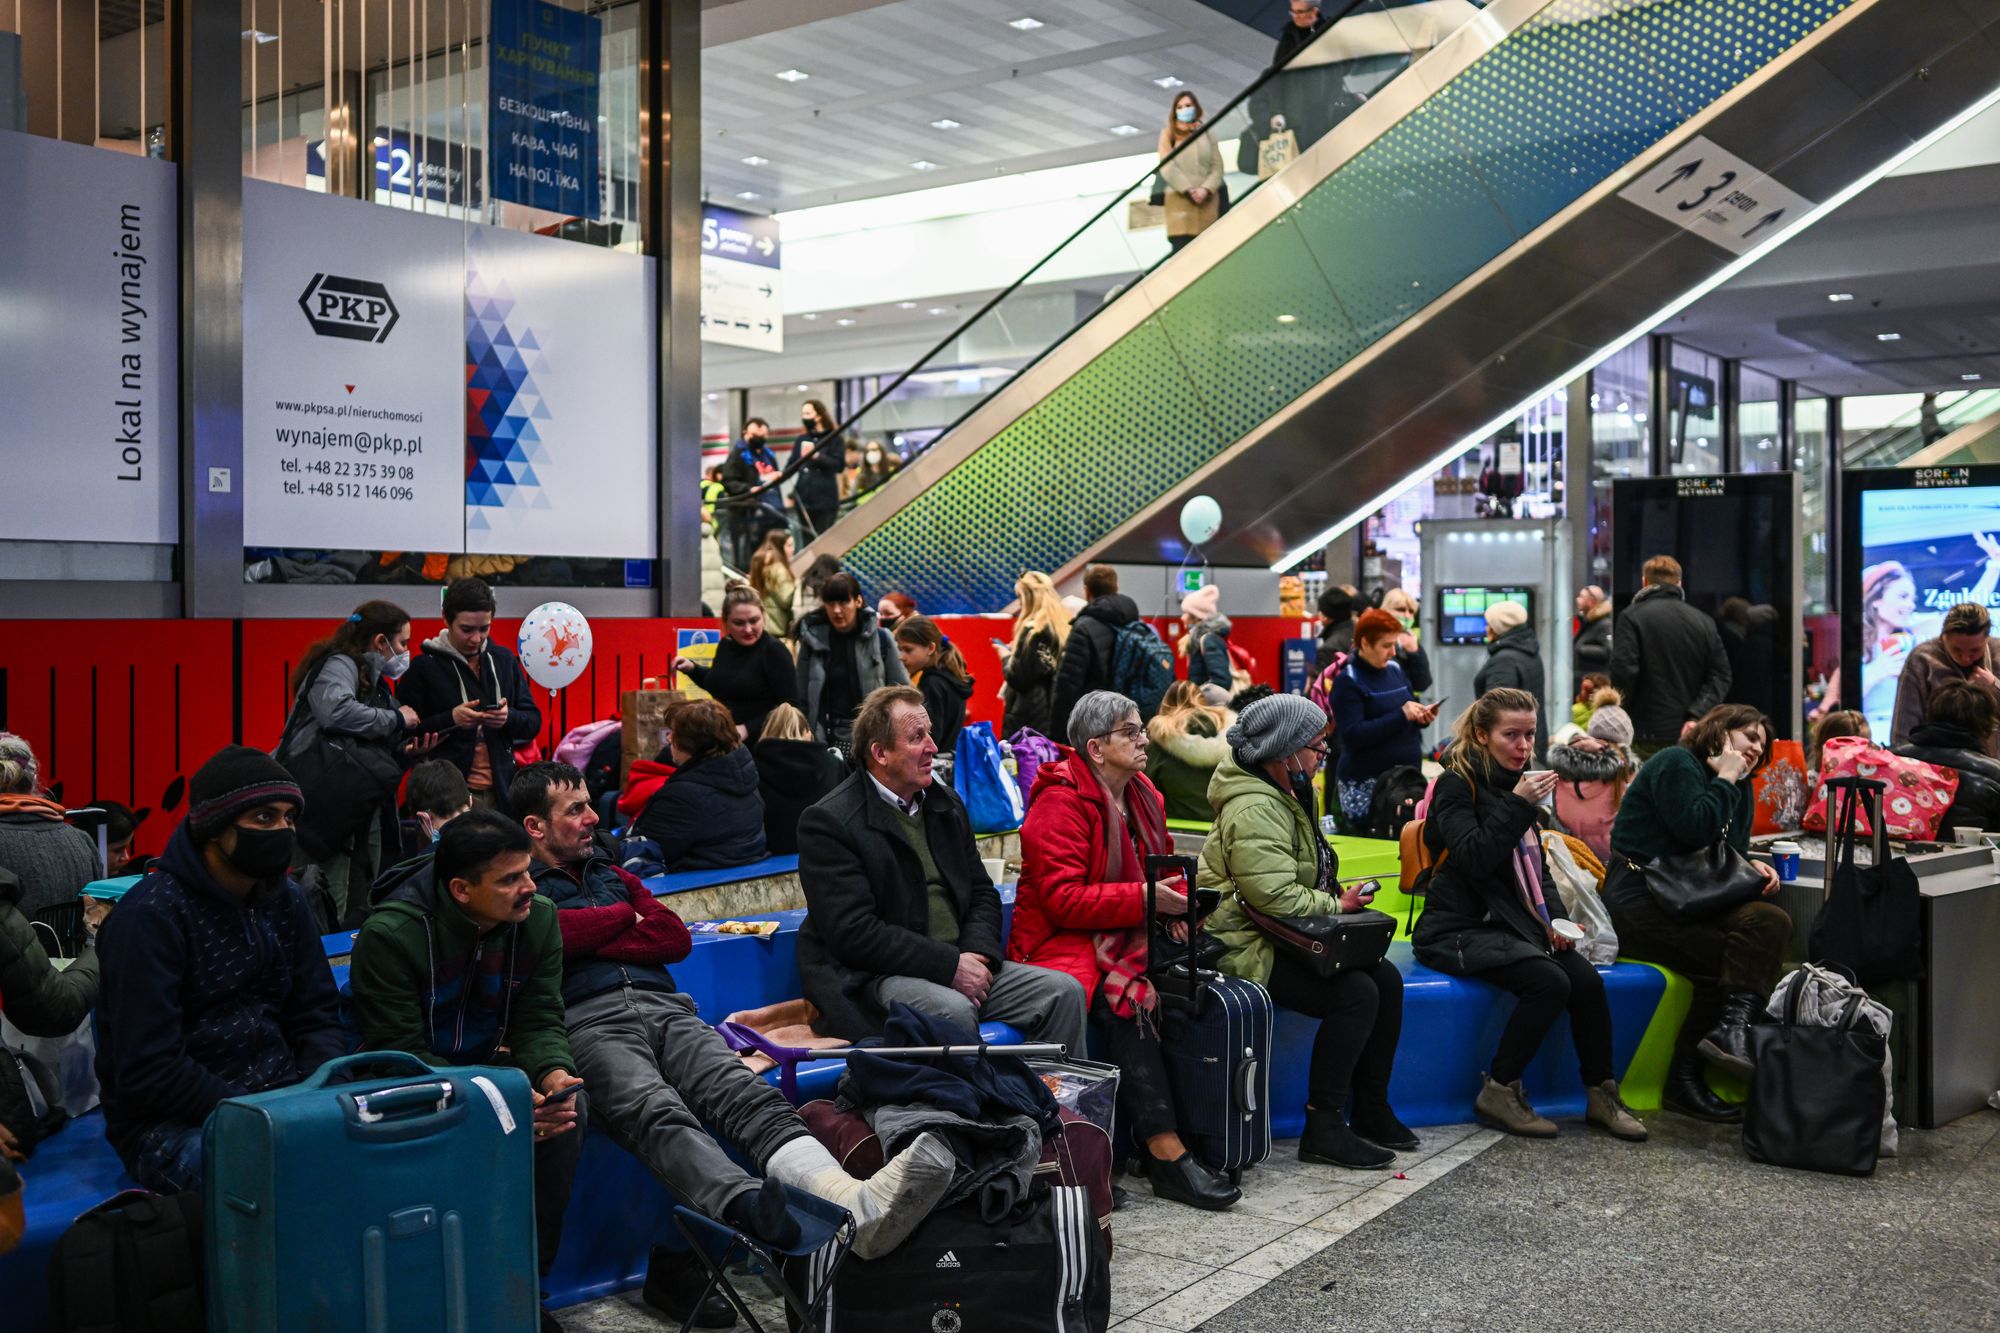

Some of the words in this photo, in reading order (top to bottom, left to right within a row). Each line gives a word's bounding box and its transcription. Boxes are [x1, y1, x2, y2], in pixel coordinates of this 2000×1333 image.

[521, 32, 571, 60] ПУНКТ
[499, 97, 590, 133] БЕЗКОШТОВНА
[511, 132, 550, 155] КАВА,
[551, 142, 578, 160] ЧАЙ
[509, 163, 553, 187] НАПОЇ,
[555, 170, 580, 191] ЇЖА
[1677, 171, 1737, 212] 3
[701, 217, 718, 250] 5
[113, 204, 147, 344] wynajem
[317, 292, 387, 324] PKP
[121, 353, 141, 390] na
[275, 400, 423, 423] www.pkpsa.pl/nieruchomosci
[115, 400, 142, 481] Lokal
[275, 427, 423, 456] wynajem@pkp.pl
[281, 458, 301, 473] tel.
[305, 460, 331, 475] +48
[334, 461, 350, 476] 22
[353, 463, 377, 478] 375
[380, 465, 396, 479] 39
[398, 466, 414, 480] 08
[1915, 478, 1969, 487] NETWORK
[283, 480, 304, 495] tel.
[307, 482, 333, 497] +48
[337, 483, 360, 498] 512
[365, 484, 387, 499] 146
[390, 486, 413, 500] 096
